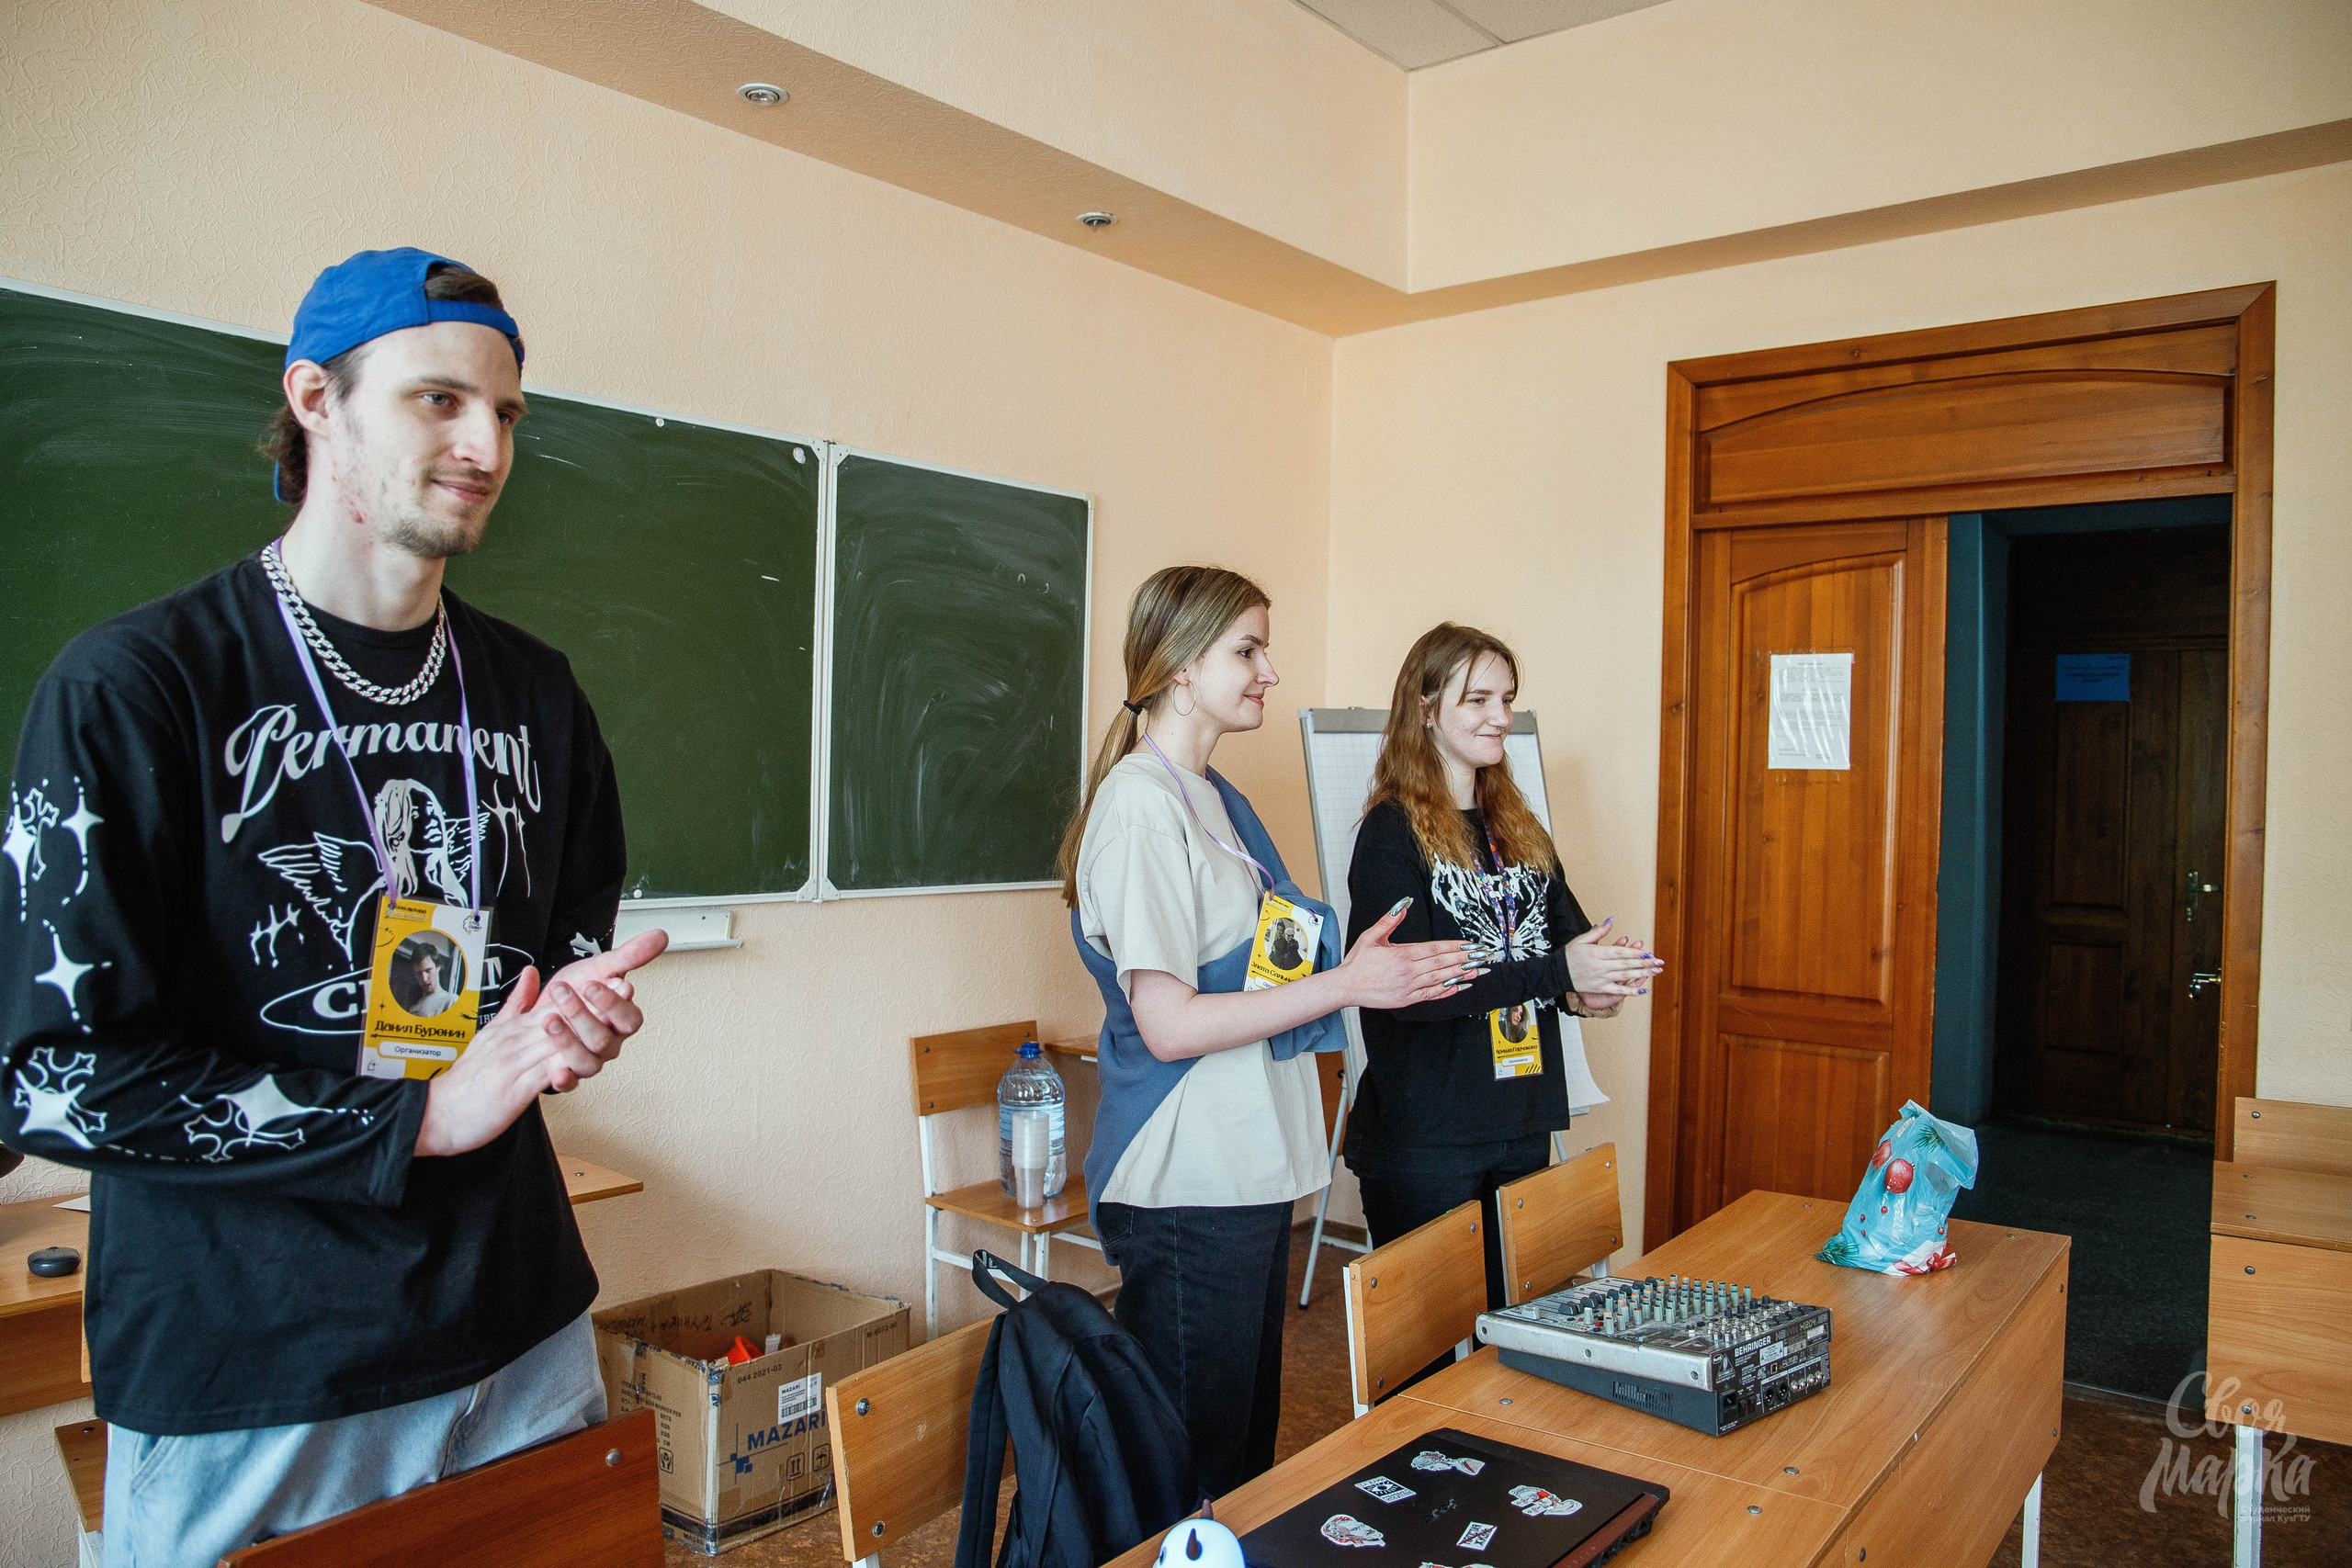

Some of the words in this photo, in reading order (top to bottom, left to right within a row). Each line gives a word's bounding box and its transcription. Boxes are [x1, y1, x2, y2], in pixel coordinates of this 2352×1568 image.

[221, 704, 541, 843] Permanent
[374, 1020, 413, 1033] Данил
[394, 1045, 442, 1056] Организатор
[1734, 1335, 1771, 1357] BEHRINGER
[737, 1374, 752, 1384] 044
